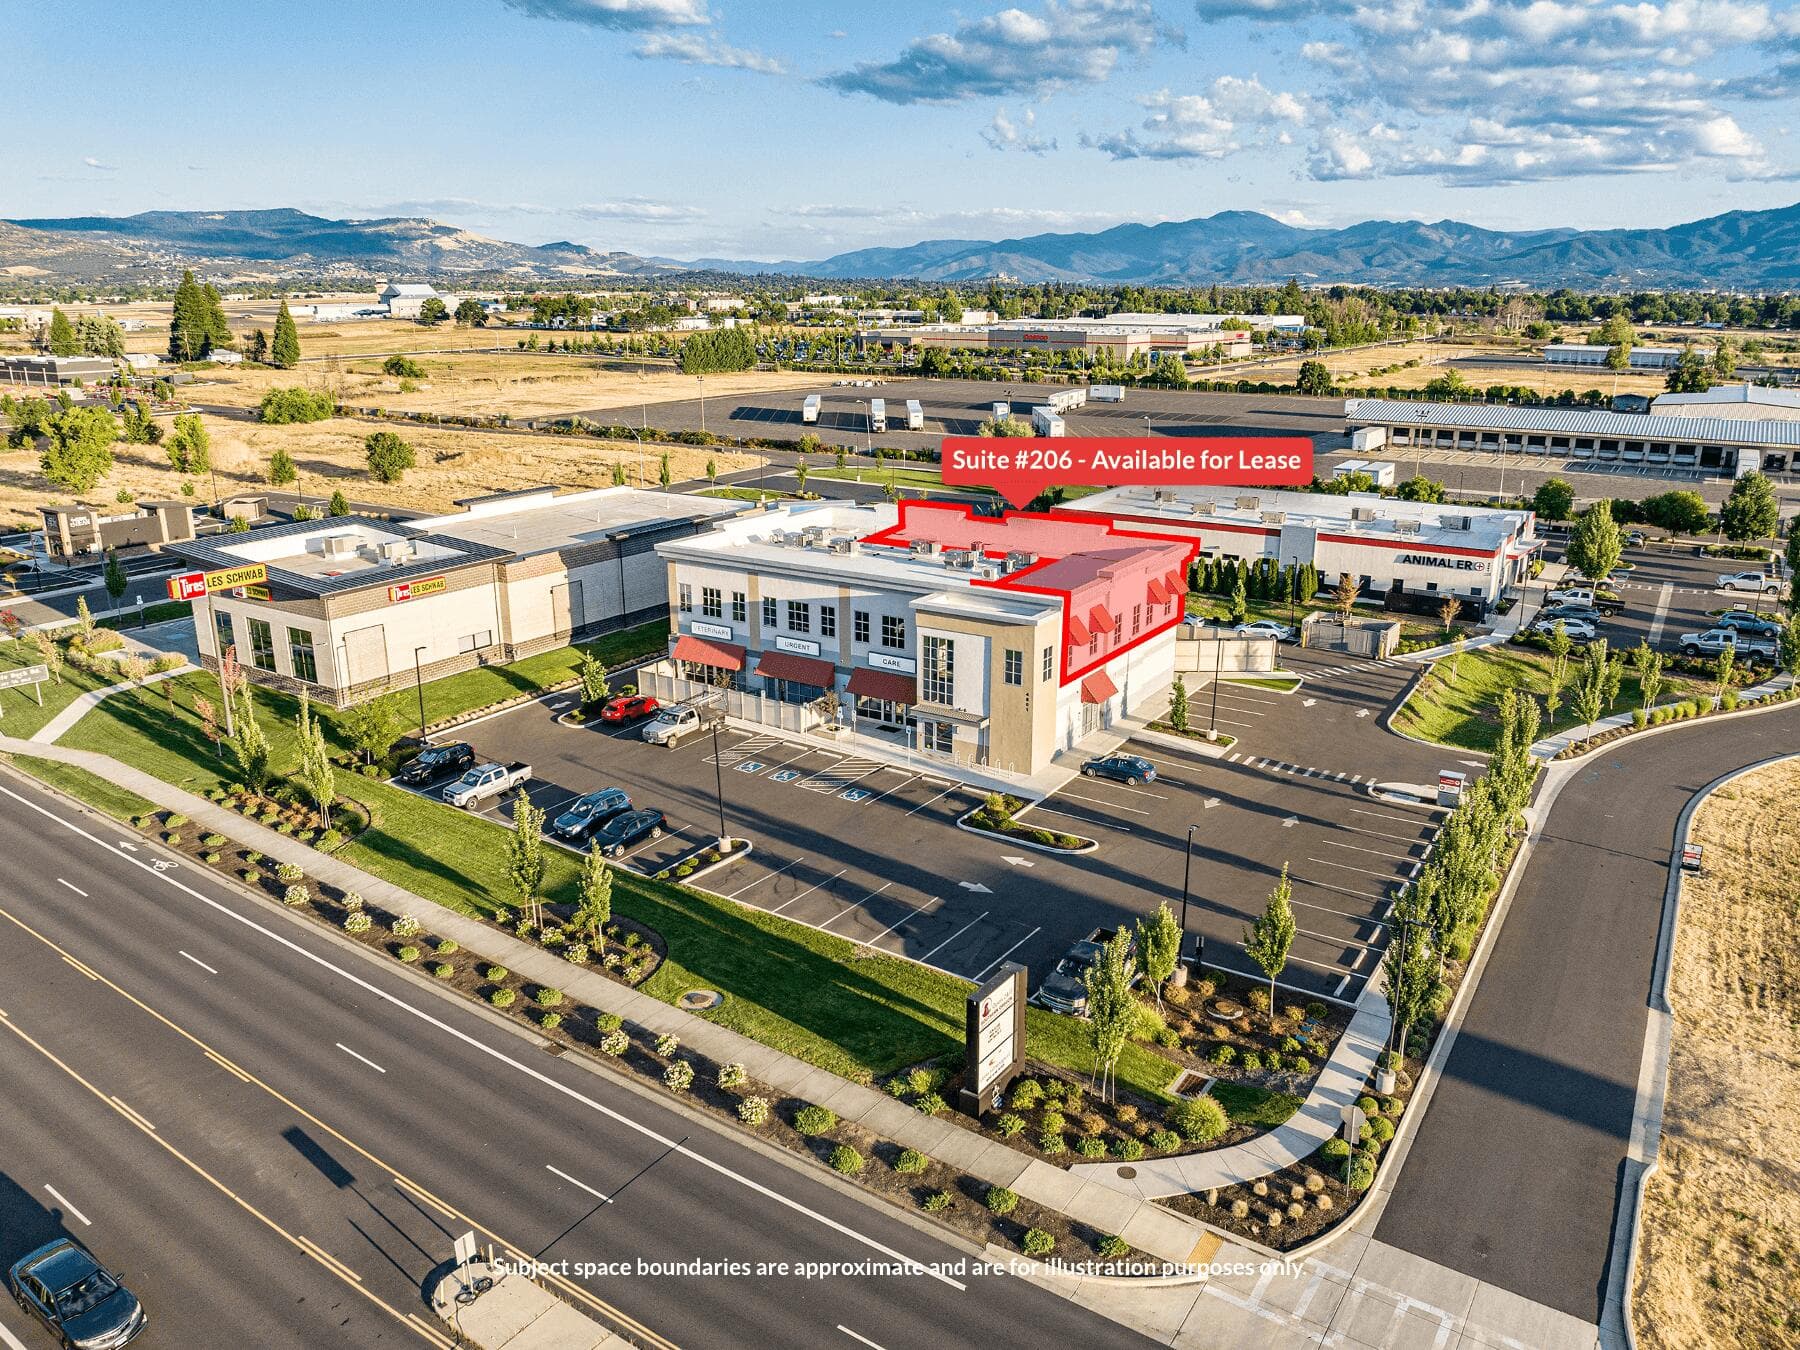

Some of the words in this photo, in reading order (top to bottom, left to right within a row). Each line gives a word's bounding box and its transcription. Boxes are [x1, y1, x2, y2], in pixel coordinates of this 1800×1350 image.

[1402, 555, 1454, 569] ANIMAL
[1456, 560, 1473, 571] ER
[206, 575, 224, 588] LES
[226, 568, 264, 585] SCHWAB
[180, 578, 205, 598] Tires
[693, 624, 730, 637] VETERINARY
[784, 640, 811, 651] URGENT
[882, 658, 901, 667] CARE
